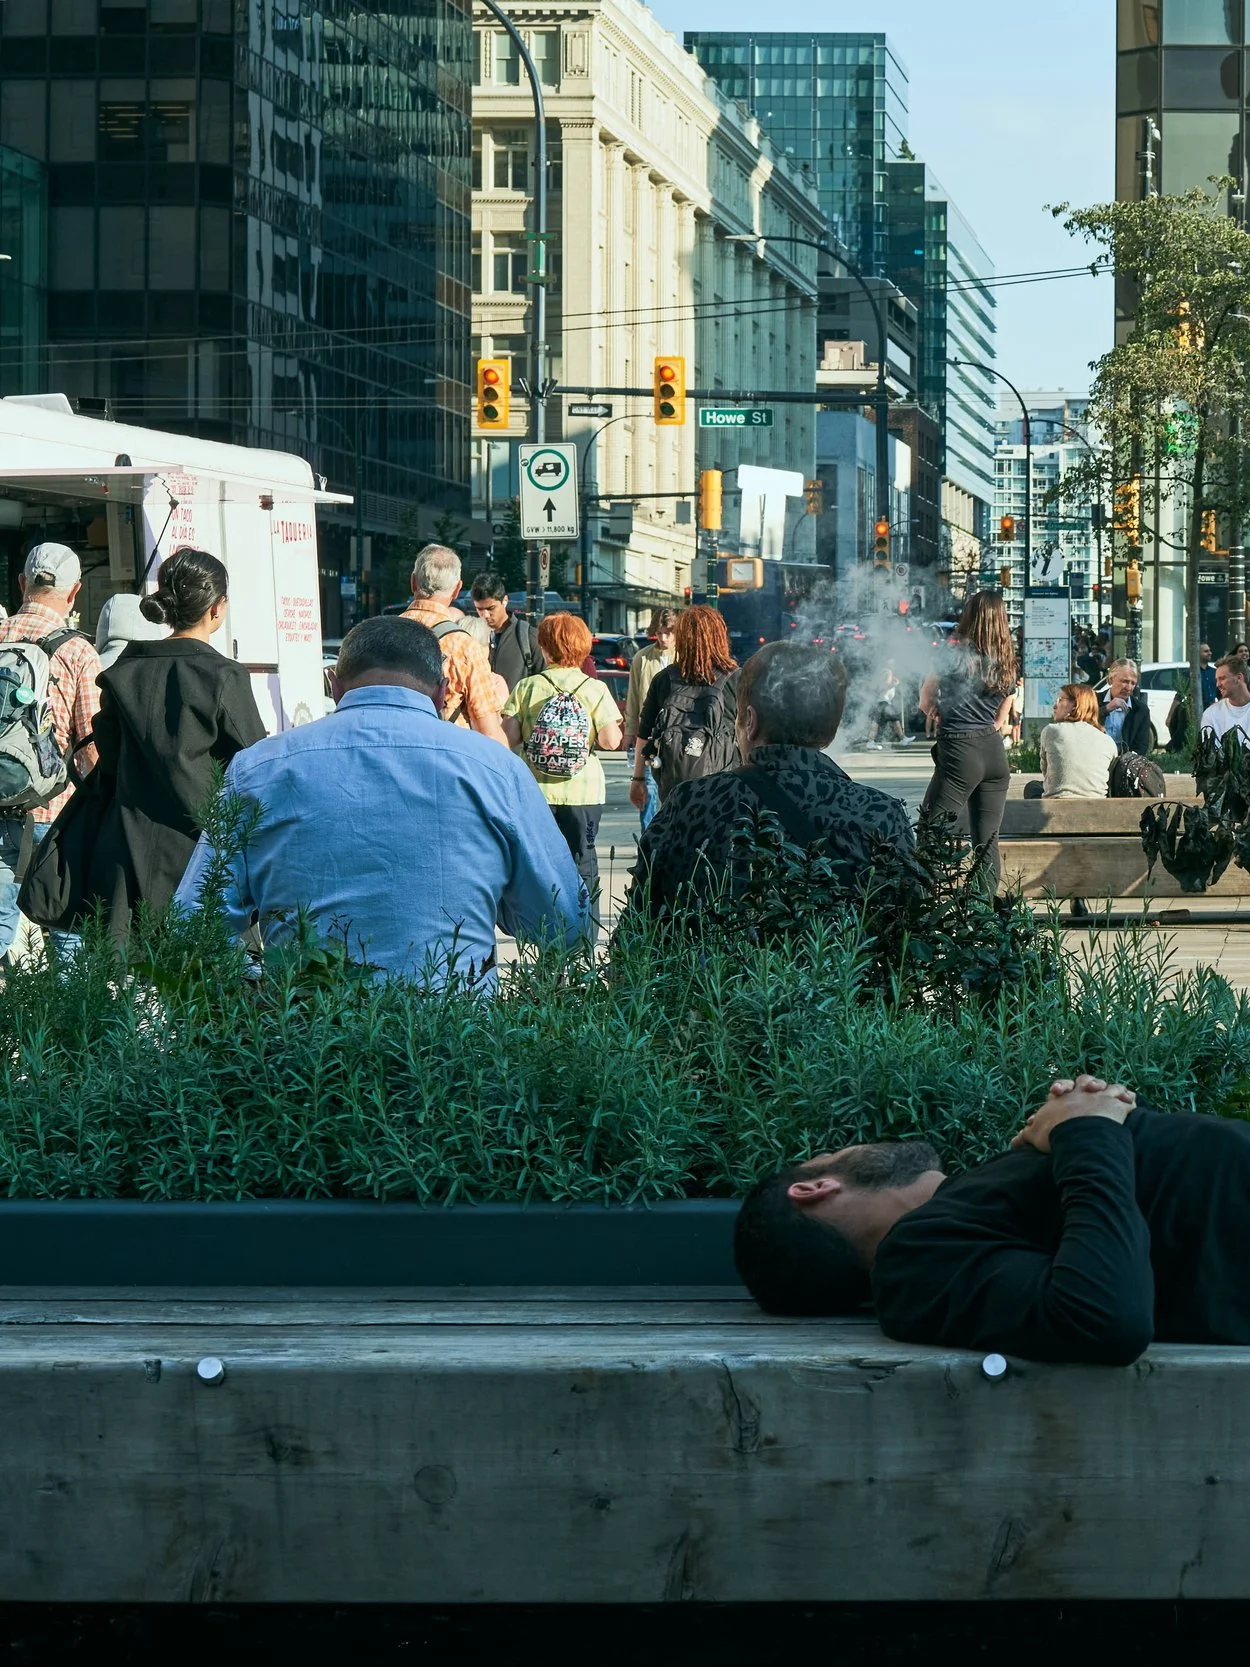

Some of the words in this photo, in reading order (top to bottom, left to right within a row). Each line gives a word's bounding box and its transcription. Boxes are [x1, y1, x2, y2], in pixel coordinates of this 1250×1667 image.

[706, 411, 745, 424] Howe
[752, 411, 767, 424] St
[547, 526, 565, 534] 11,800
[567, 526, 575, 534] kg
